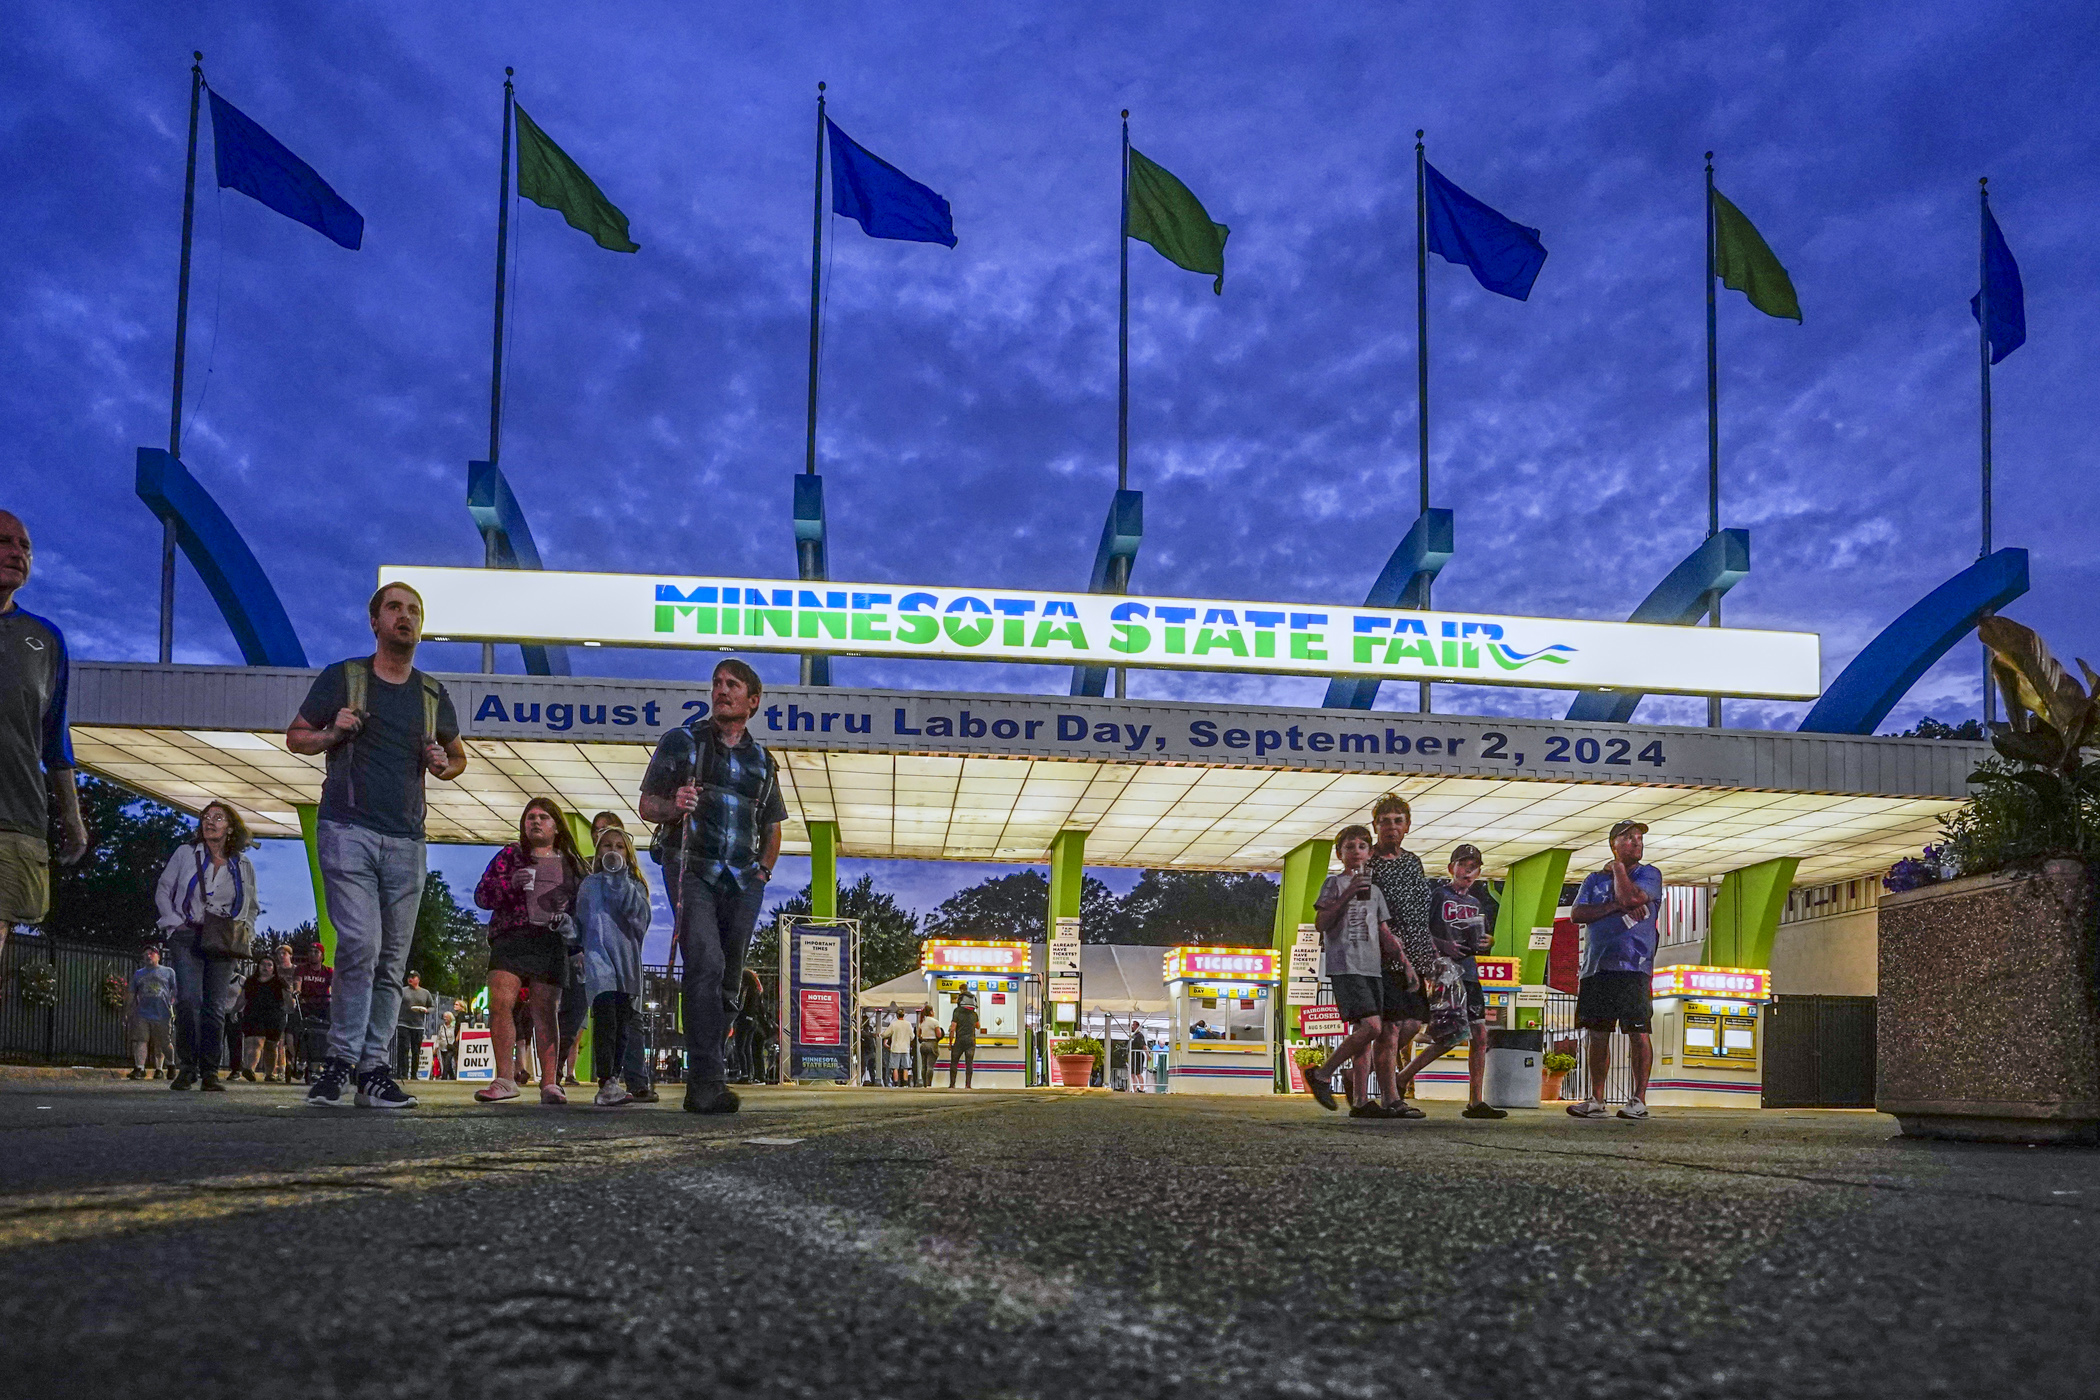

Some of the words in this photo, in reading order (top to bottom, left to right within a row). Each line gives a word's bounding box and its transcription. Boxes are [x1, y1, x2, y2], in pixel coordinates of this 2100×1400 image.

[655, 584, 1089, 649] MINNESOTA
[1109, 602, 1328, 660] STATE
[1353, 615, 1514, 670] FAIR
[474, 693, 661, 731] August
[681, 700, 710, 726] 2
[765, 703, 872, 734] thru
[894, 708, 1045, 739] Labor
[1056, 714, 1166, 751] Day,
[1188, 719, 1466, 757] September
[1481, 732, 1525, 767] 2,
[1544, 736, 1666, 767] 2024
[943, 950, 1014, 964] TICKETS
[1195, 956, 1263, 971] TICKETS
[1690, 975, 1754, 990] TICKETS
[1303, 1006, 1339, 1015] FAIRGROUN
[466, 1045, 488, 1053] EXIT
[464, 1058, 489, 1067] ONLY
